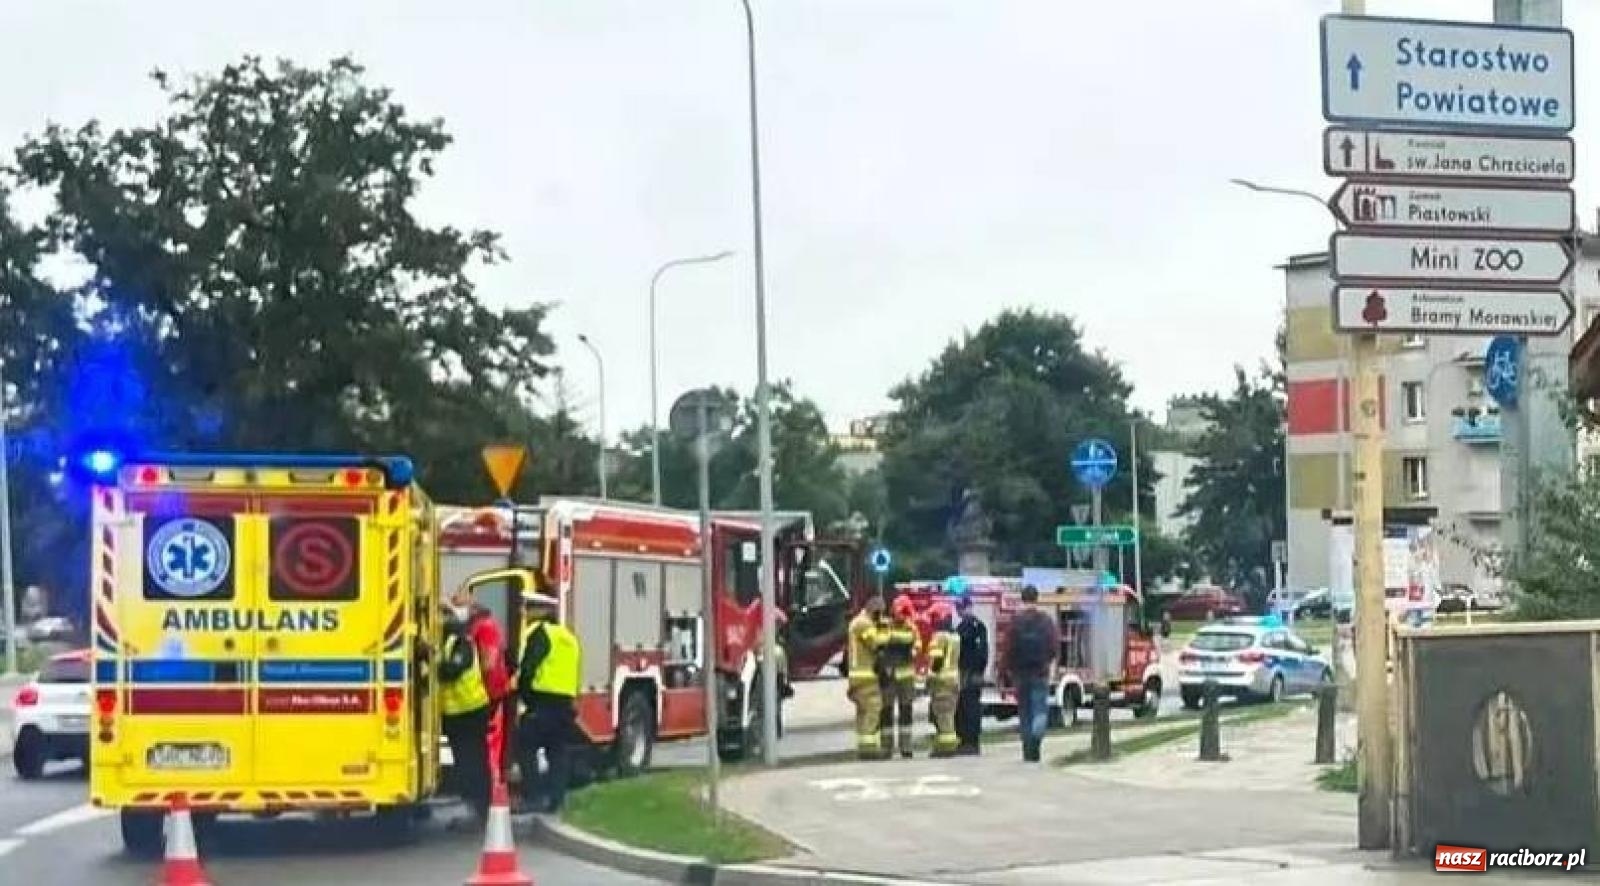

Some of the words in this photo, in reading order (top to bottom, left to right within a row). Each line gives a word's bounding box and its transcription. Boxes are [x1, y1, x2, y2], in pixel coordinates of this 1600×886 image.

[1397, 38, 1549, 72] Starostwo
[1397, 81, 1559, 117] Powiatowe
[1408, 203, 1492, 222] Piastowski
[1411, 246, 1459, 271] Mini
[1474, 248, 1524, 272] ZOO
[1411, 307, 1462, 326] Bramy
[1470, 309, 1557, 329] Morawskiej
[162, 608, 340, 632] AMBULANS
